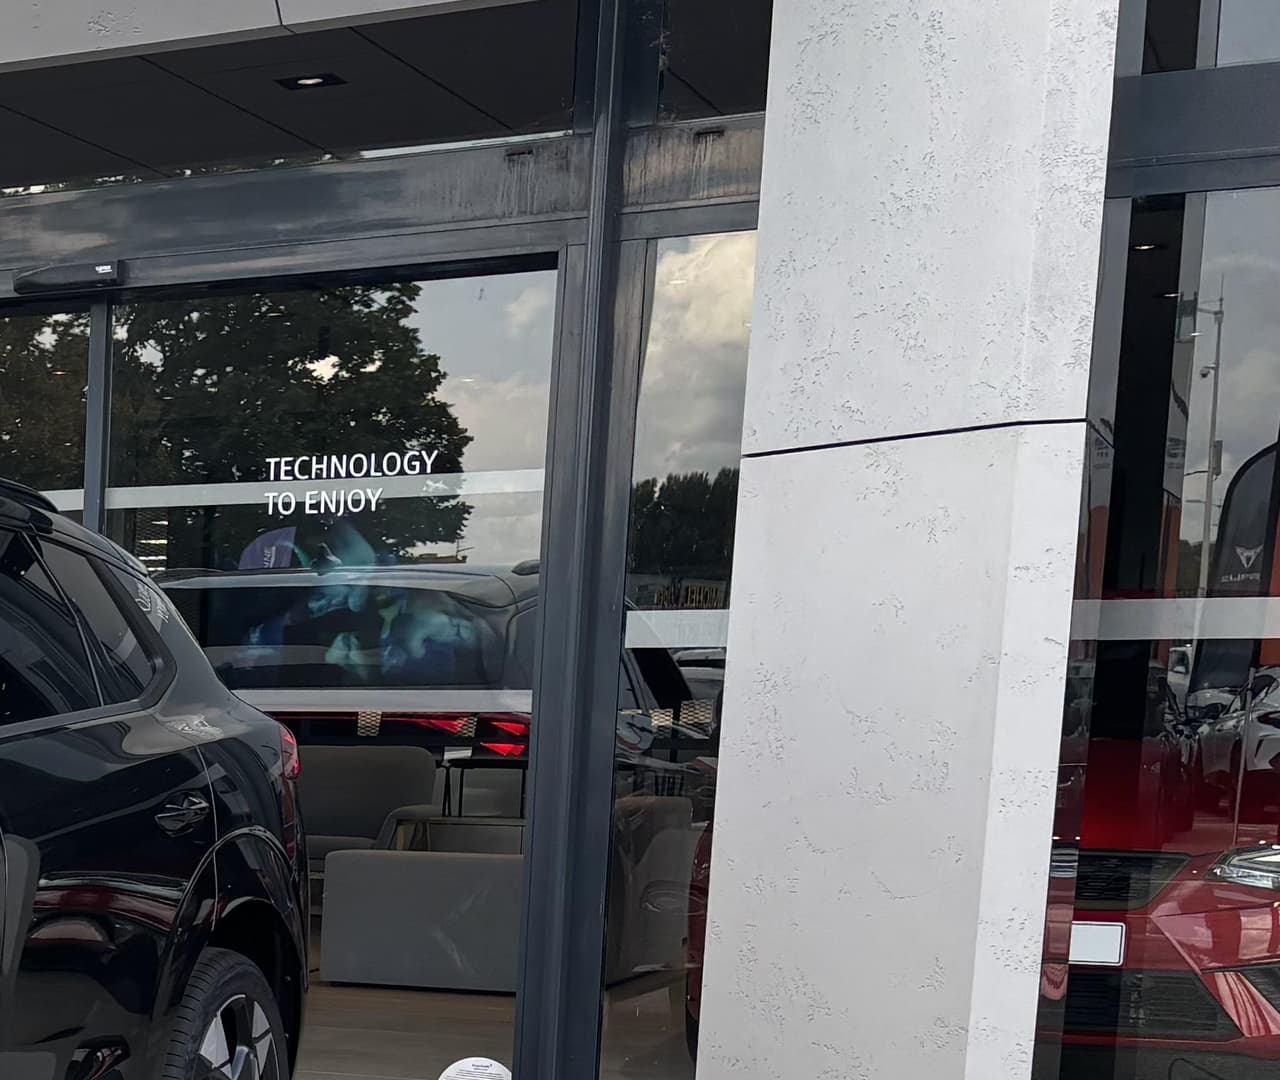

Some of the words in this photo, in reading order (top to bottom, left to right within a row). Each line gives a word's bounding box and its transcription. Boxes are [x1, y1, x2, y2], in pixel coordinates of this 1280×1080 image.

[265, 450, 439, 481] TECHNOLOGY
[264, 491, 296, 516] TO
[304, 487, 384, 517] ENJOY
